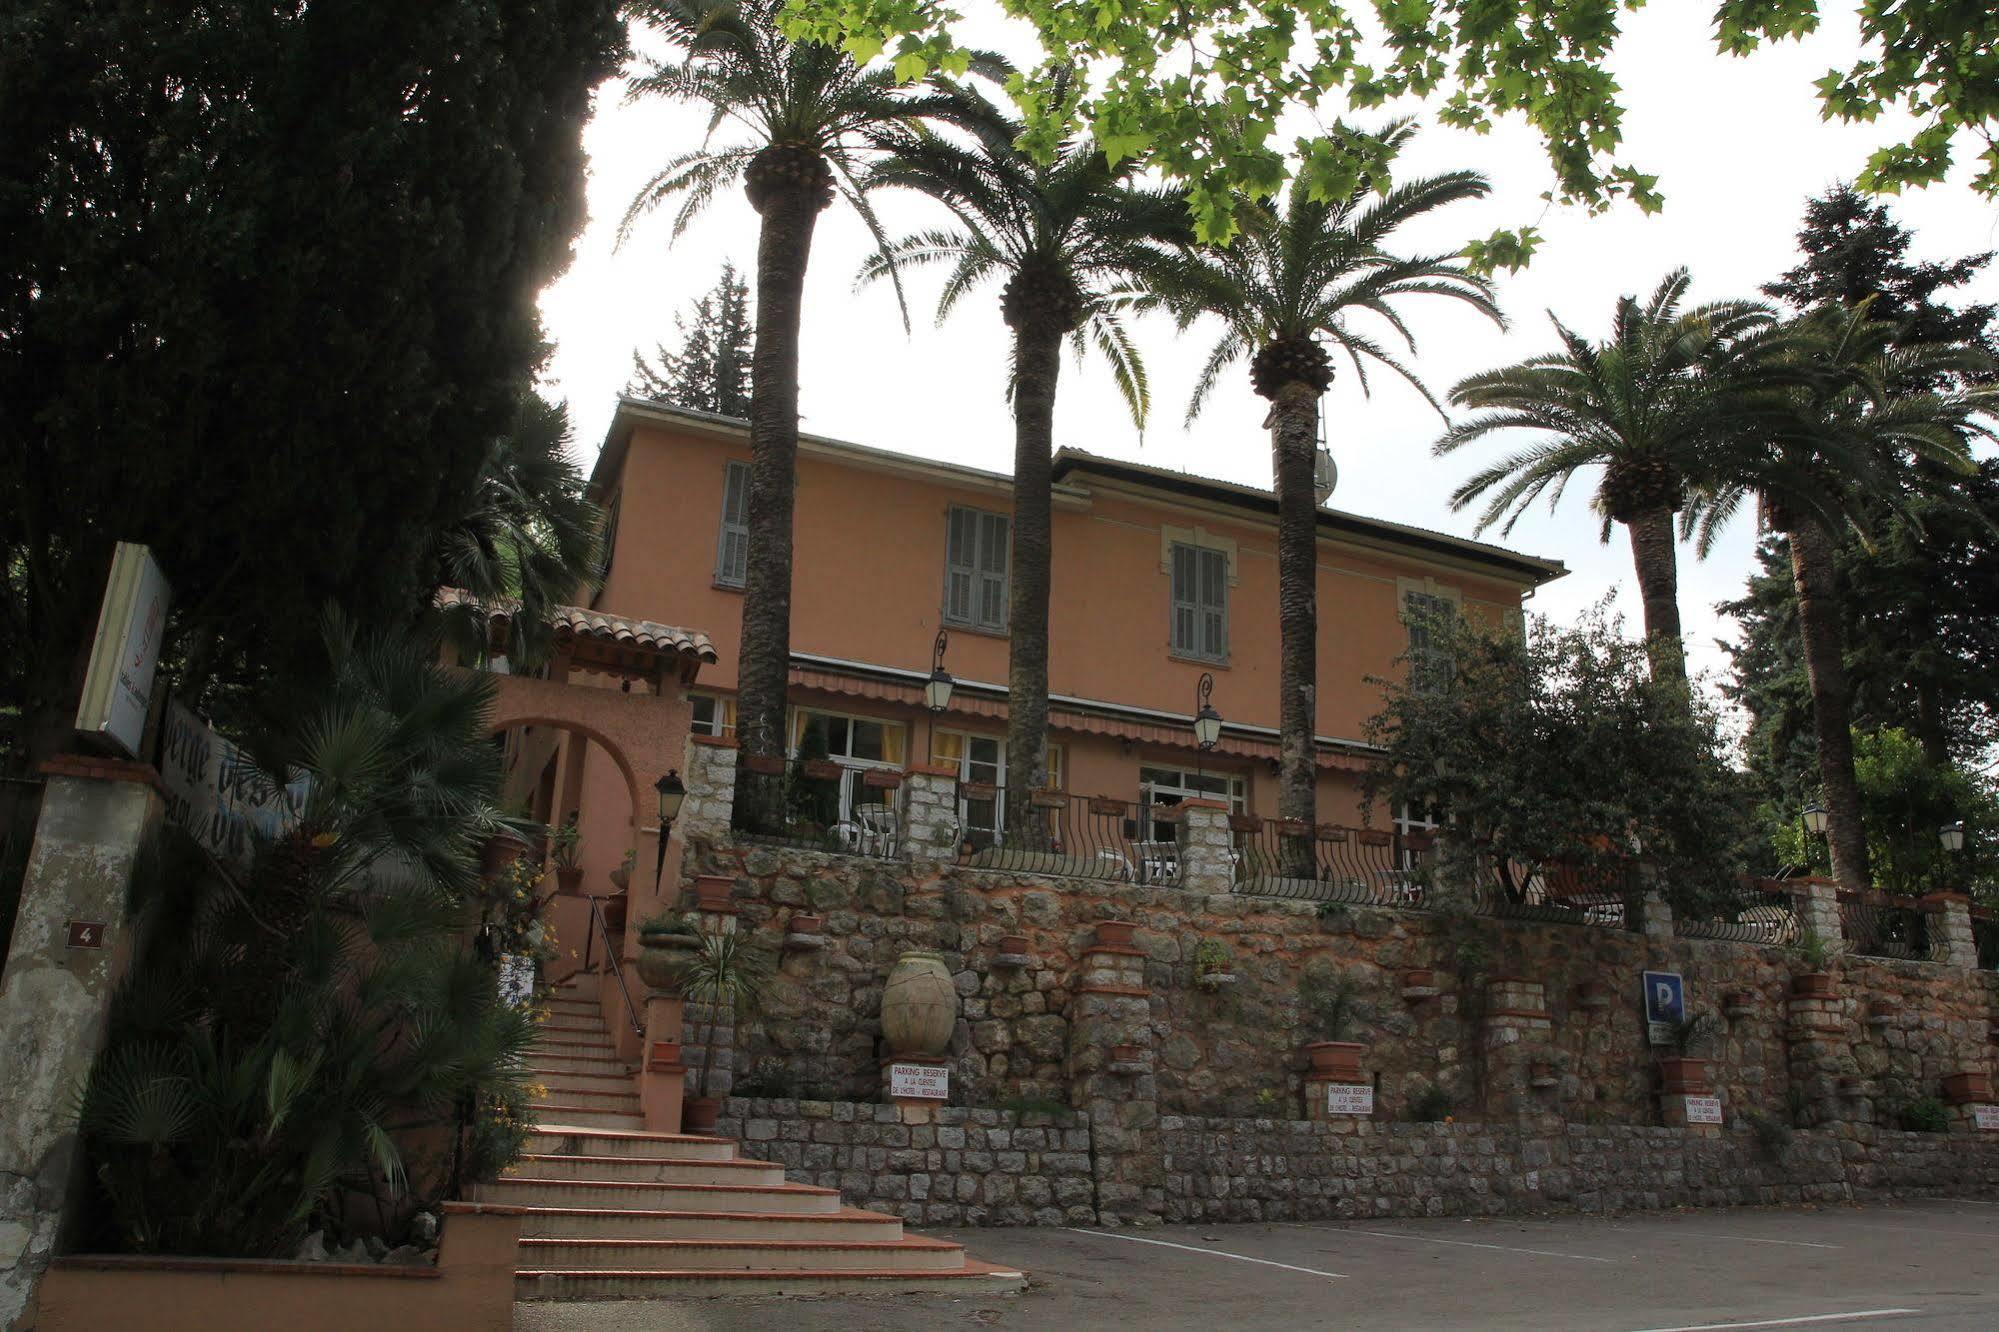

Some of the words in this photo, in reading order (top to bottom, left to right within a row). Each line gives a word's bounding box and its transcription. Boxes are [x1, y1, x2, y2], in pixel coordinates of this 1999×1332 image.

[80, 927, 92, 943] 4
[1656, 982, 1674, 1012] P
[894, 1066, 920, 1076] PARKING
[1330, 1087, 1350, 1095] PARKING
